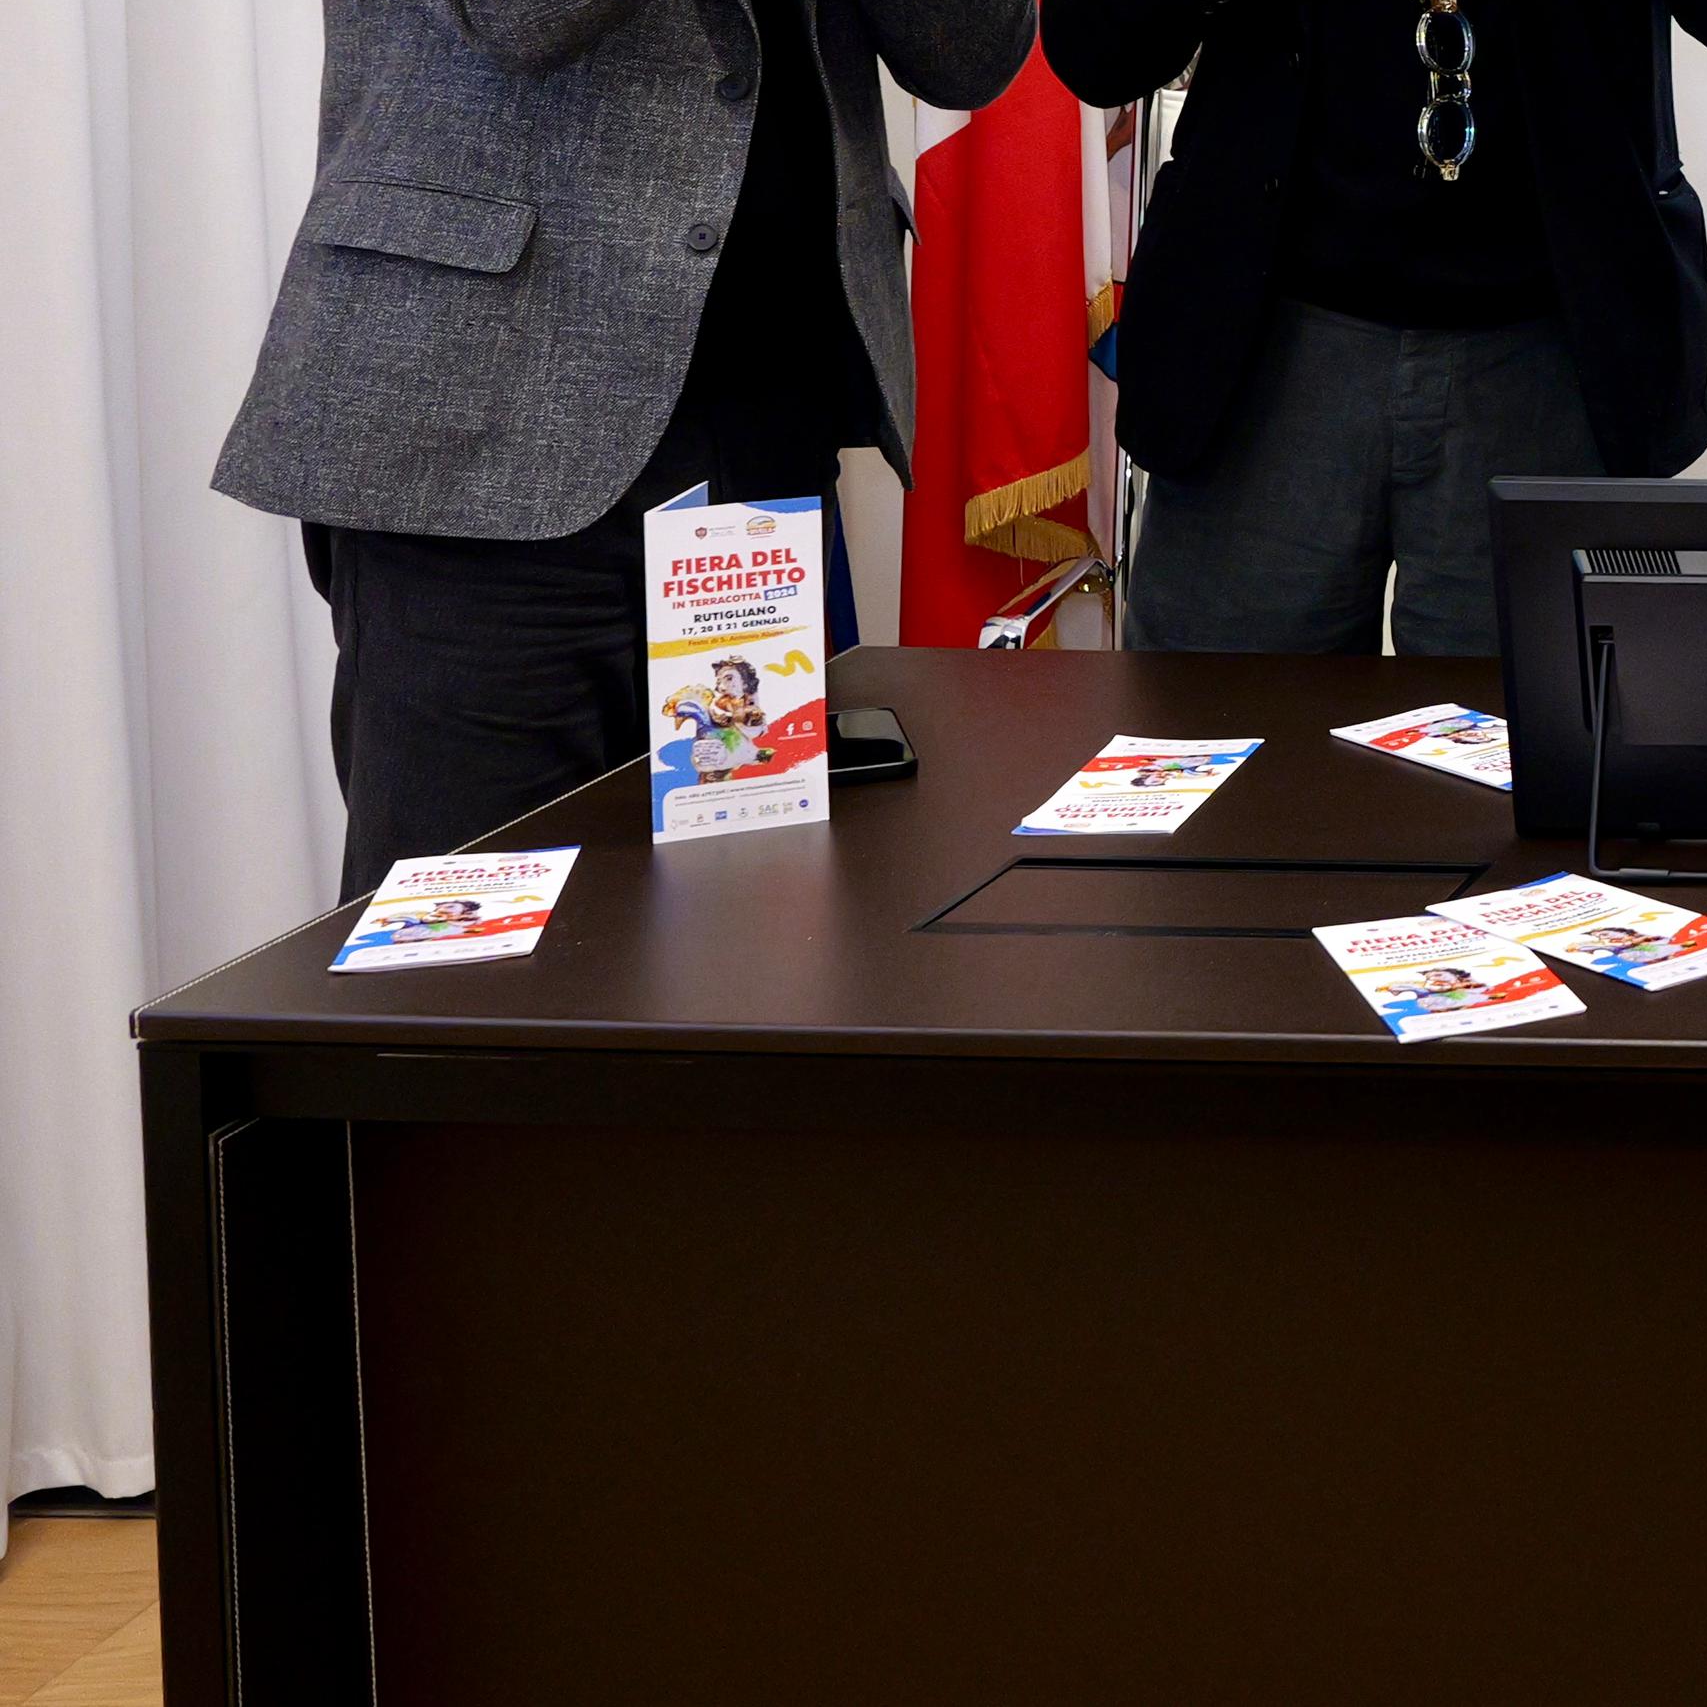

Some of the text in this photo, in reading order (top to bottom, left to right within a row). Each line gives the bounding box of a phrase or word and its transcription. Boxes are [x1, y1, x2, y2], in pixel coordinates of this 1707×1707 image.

[671, 547, 798, 577] FIERA DEL
[662, 566, 806, 598] FISCHIETTO
[671, 601, 686, 610] IN
[689, 592, 762, 608] TERRACOTTA
[693, 604, 777, 624] RUTIGLIANO
[700, 625, 714, 634] 20
[716, 624, 723, 632] E
[726, 622, 738, 631] 21
[742, 615, 790, 629] GENNAIO
